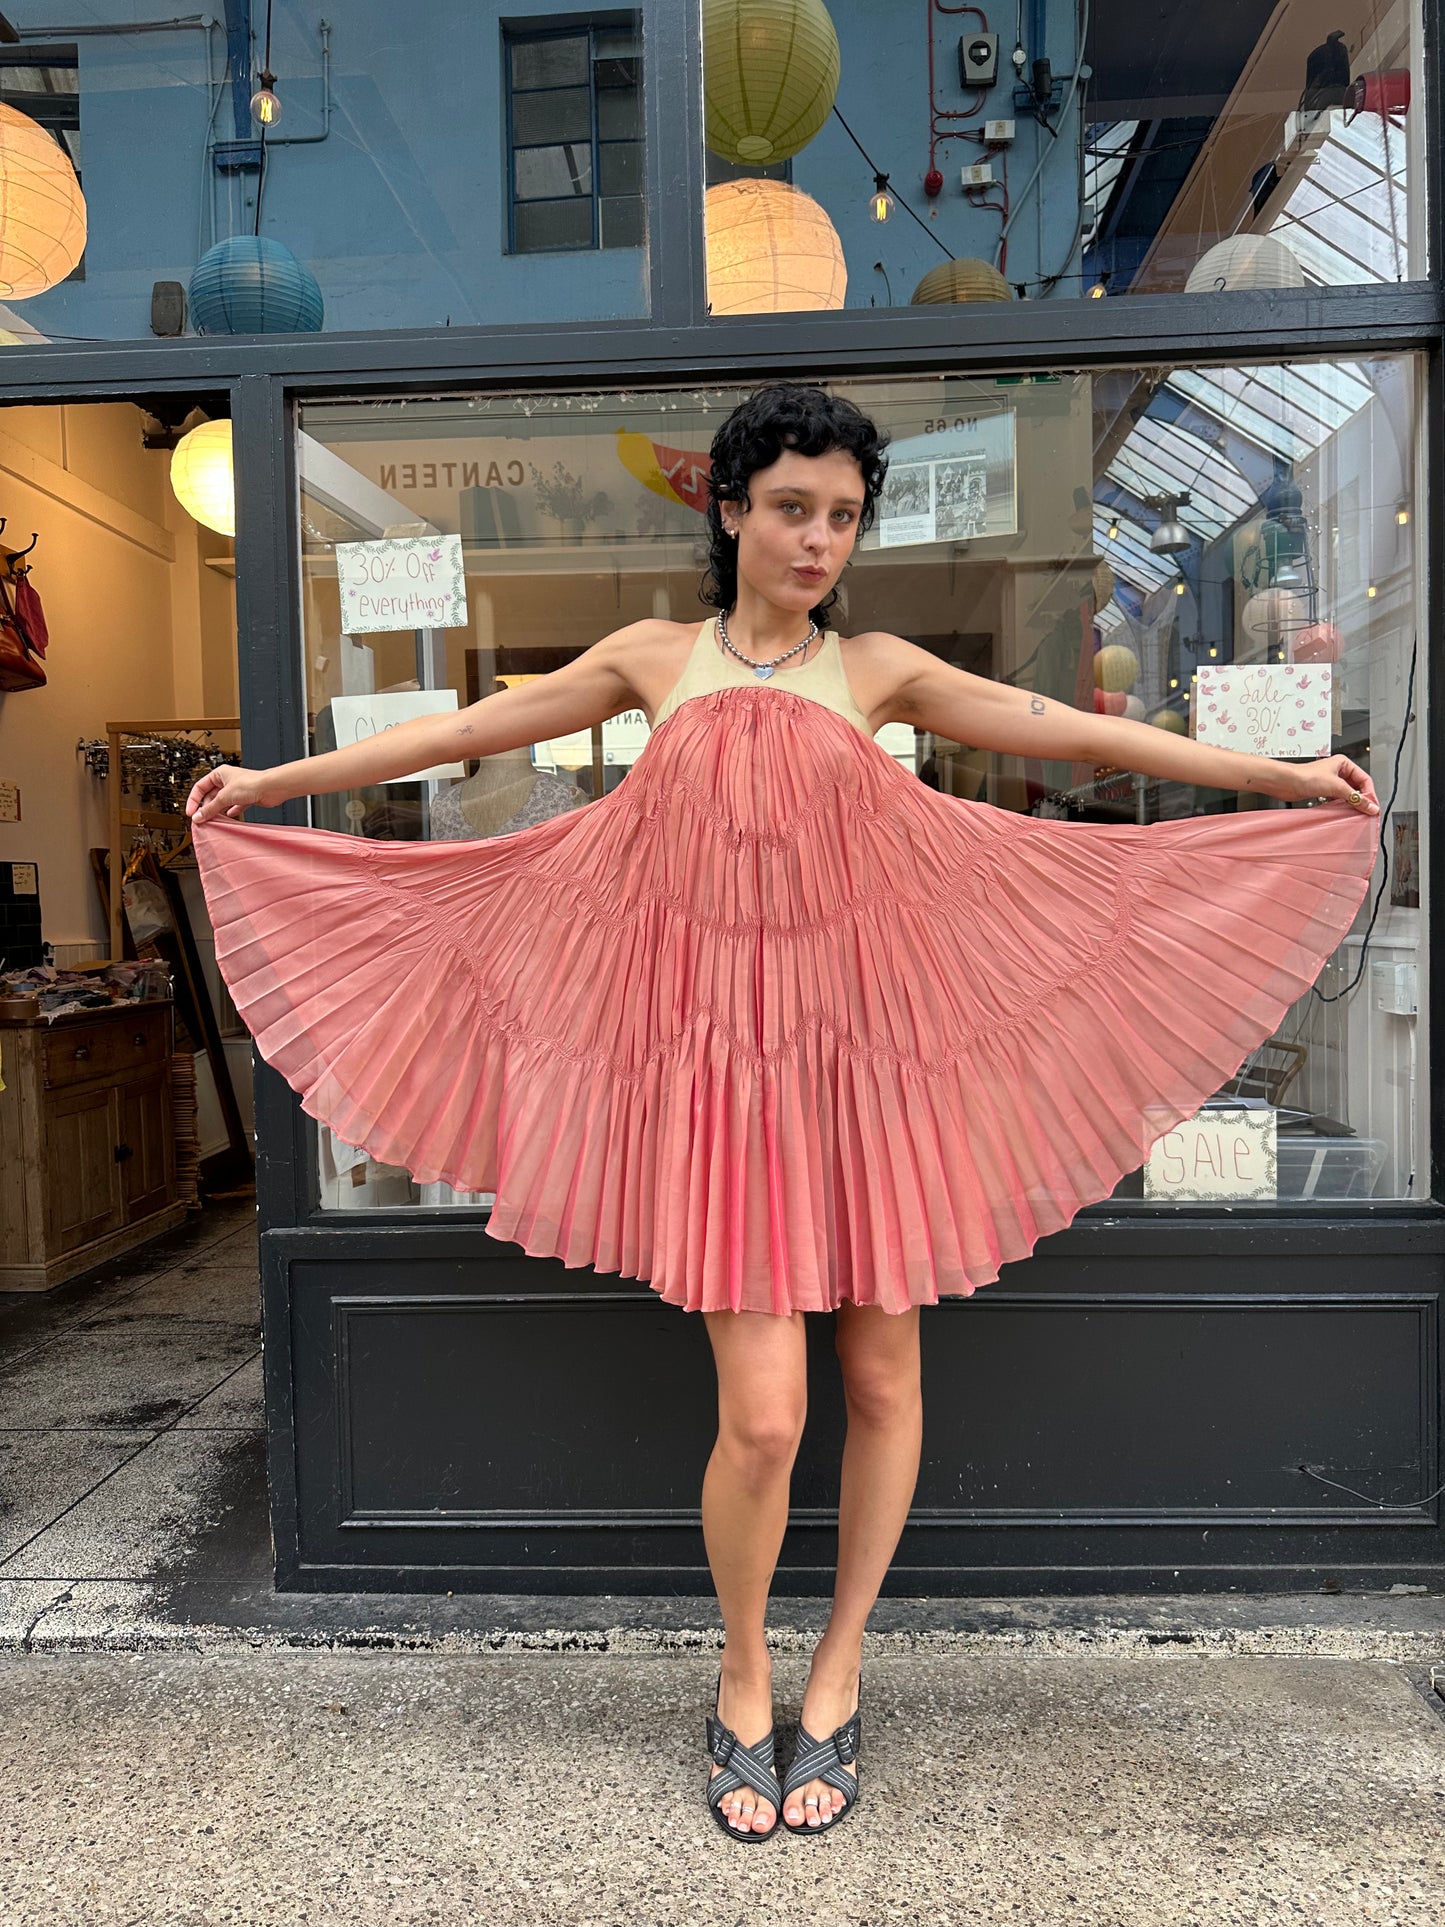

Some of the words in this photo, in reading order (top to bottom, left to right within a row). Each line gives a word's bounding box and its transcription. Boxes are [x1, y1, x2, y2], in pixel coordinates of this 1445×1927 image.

[351, 553, 396, 585] 30%
[406, 553, 436, 583] Off
[359, 592, 445, 622] everything
[1239, 674, 1294, 704] Sale
[1246, 706, 1281, 735] 30%
[1253, 736, 1268, 749] off
